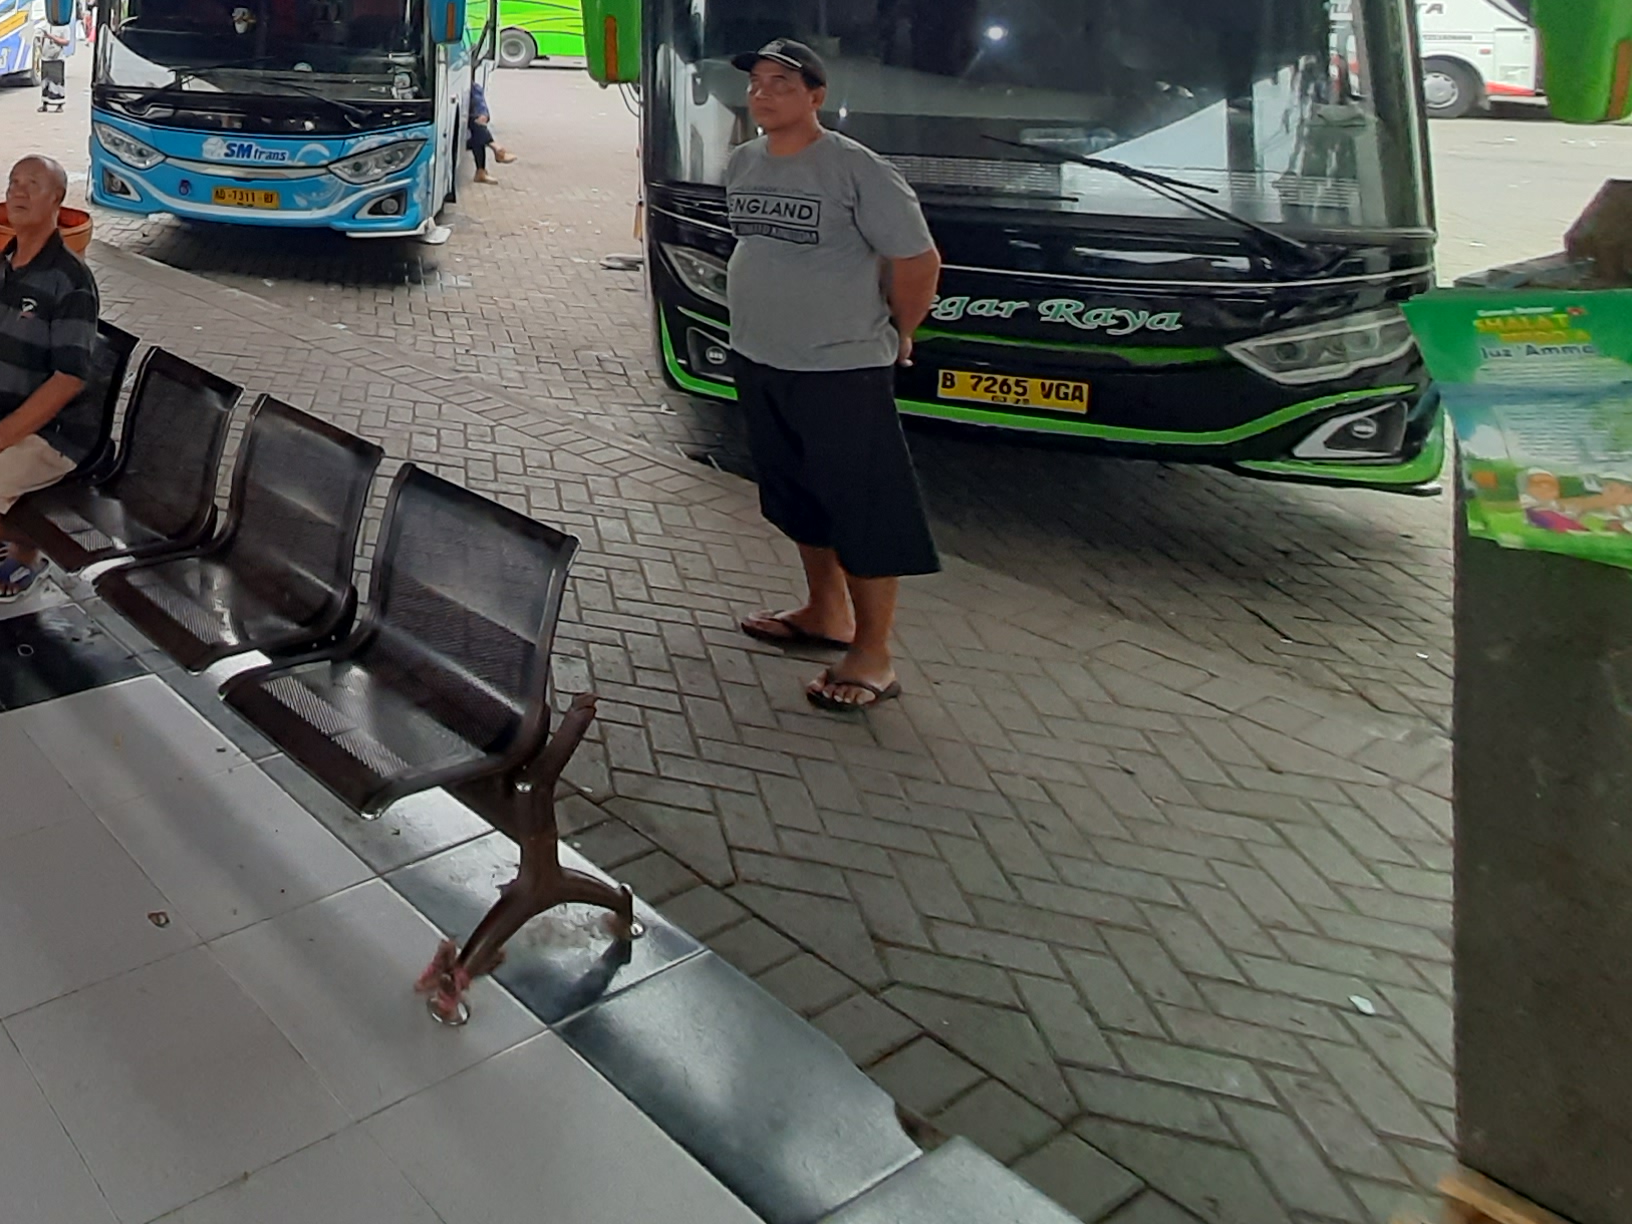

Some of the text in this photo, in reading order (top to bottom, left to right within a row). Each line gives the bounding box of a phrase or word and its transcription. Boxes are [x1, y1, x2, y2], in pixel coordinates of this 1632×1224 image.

[1038, 298, 1184, 336] Raya
[941, 372, 956, 389] B
[970, 374, 1028, 397] 7265
[1040, 381, 1085, 403] VGA
